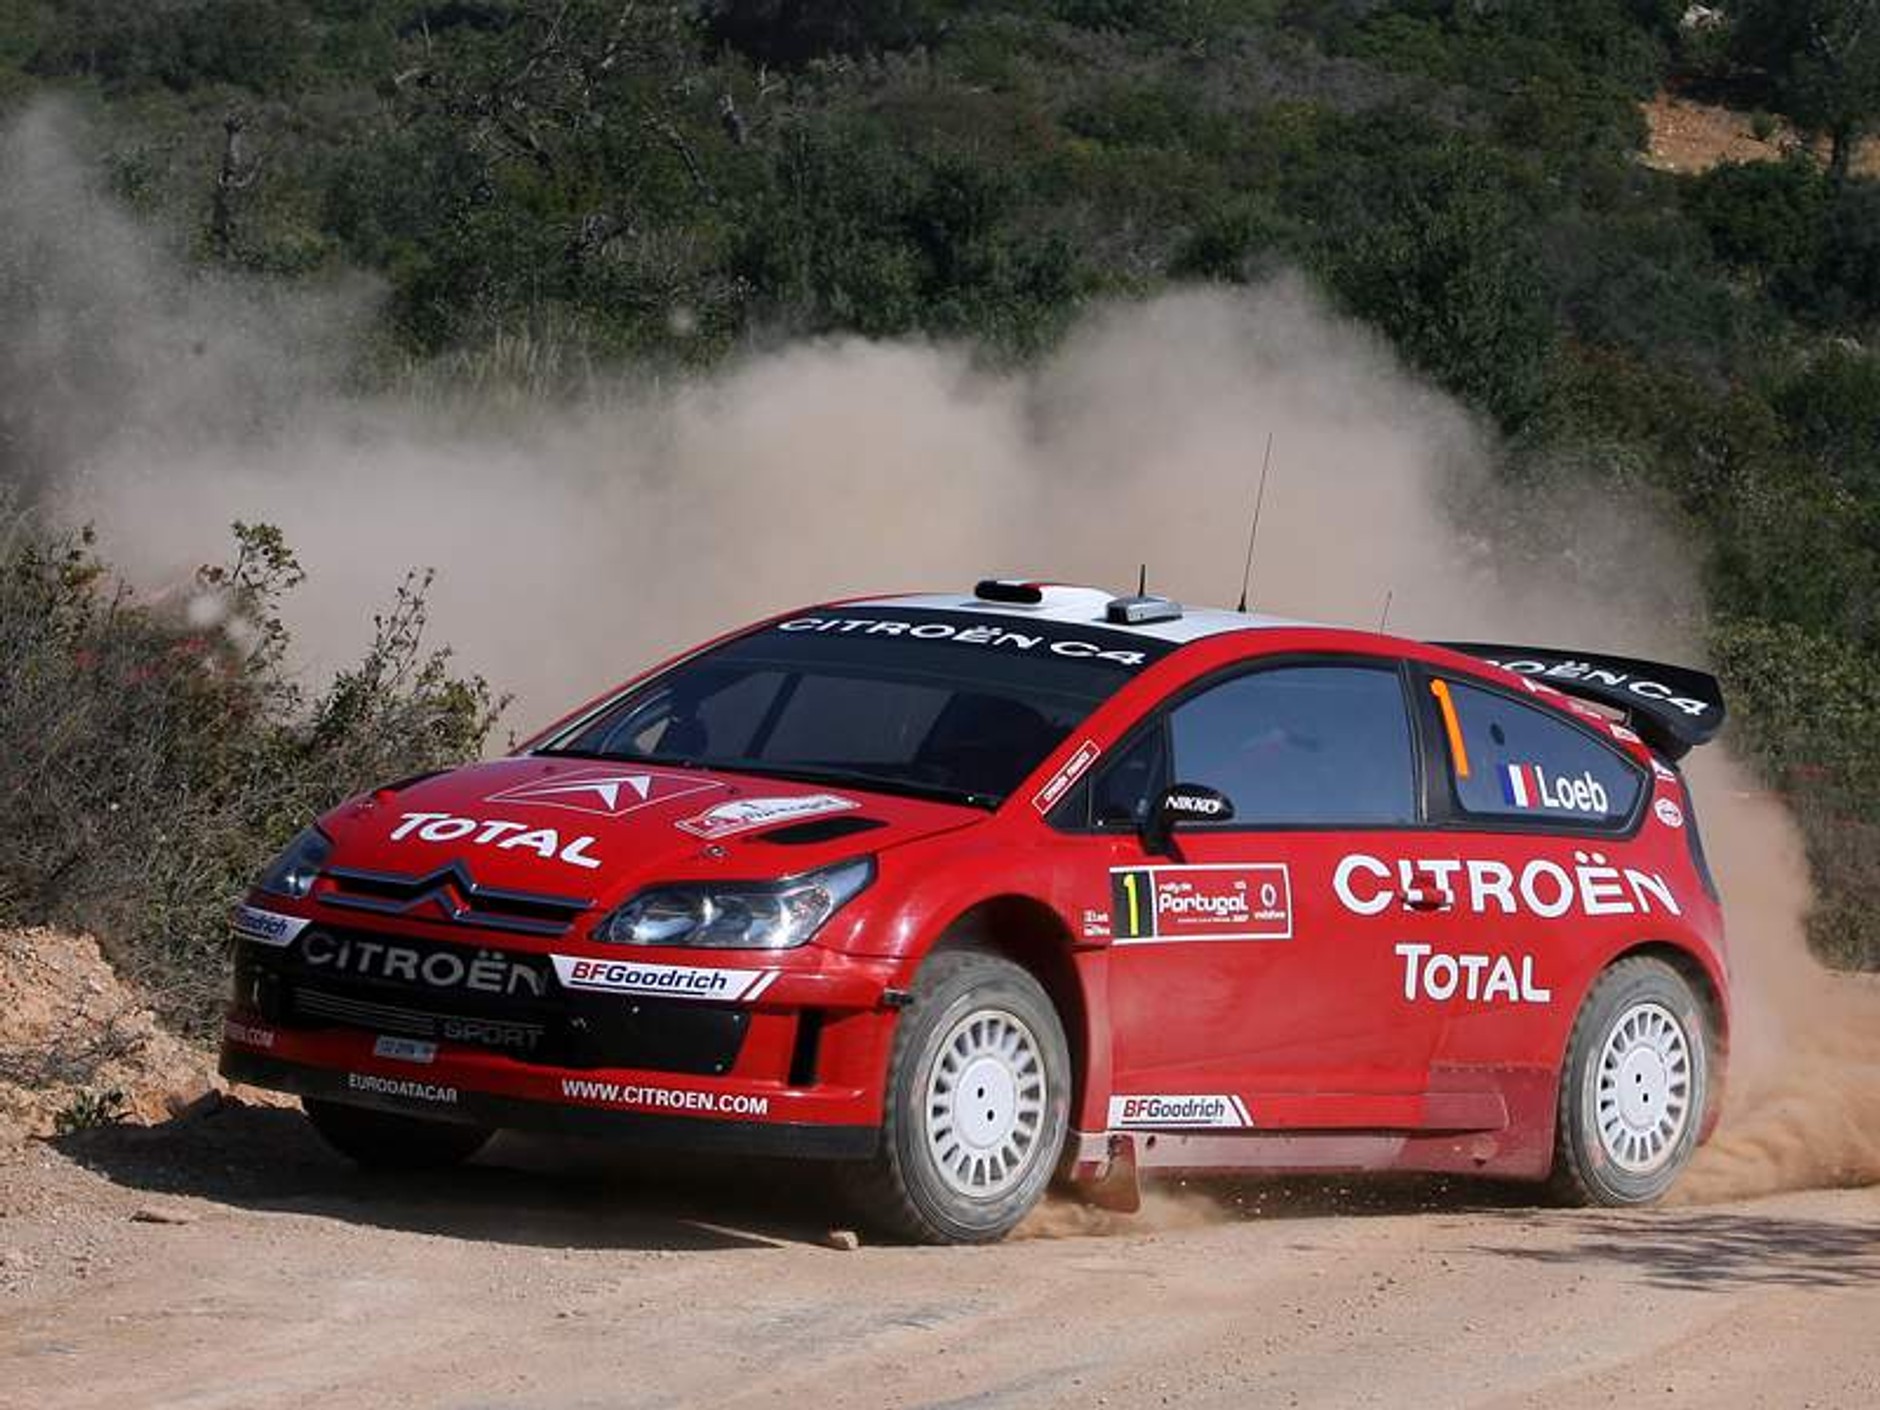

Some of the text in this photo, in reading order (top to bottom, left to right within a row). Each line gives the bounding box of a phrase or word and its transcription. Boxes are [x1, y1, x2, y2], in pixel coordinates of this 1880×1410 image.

[778, 617, 1147, 666] CITROËN C4
[1628, 681, 1708, 716] C4
[1429, 678, 1469, 780] 1
[1165, 795, 1223, 815] NIKKO
[1534, 764, 1609, 813] Loeb
[389, 812, 601, 868] TOTAL
[1123, 873, 1139, 936] 1
[1158, 892, 1248, 915] Portugal
[1333, 850, 1682, 918] CITROËN
[300, 930, 548, 997] CITROËN
[570, 961, 728, 991] BFGoodrich
[1395, 943, 1551, 1002] TOTAL
[443, 1020, 546, 1054] SPORT
[348, 1072, 458, 1103] EURODATACAR
[561, 1078, 769, 1115] WWW.CITROEN.COM
[1122, 1098, 1226, 1118] BFGoodrich
